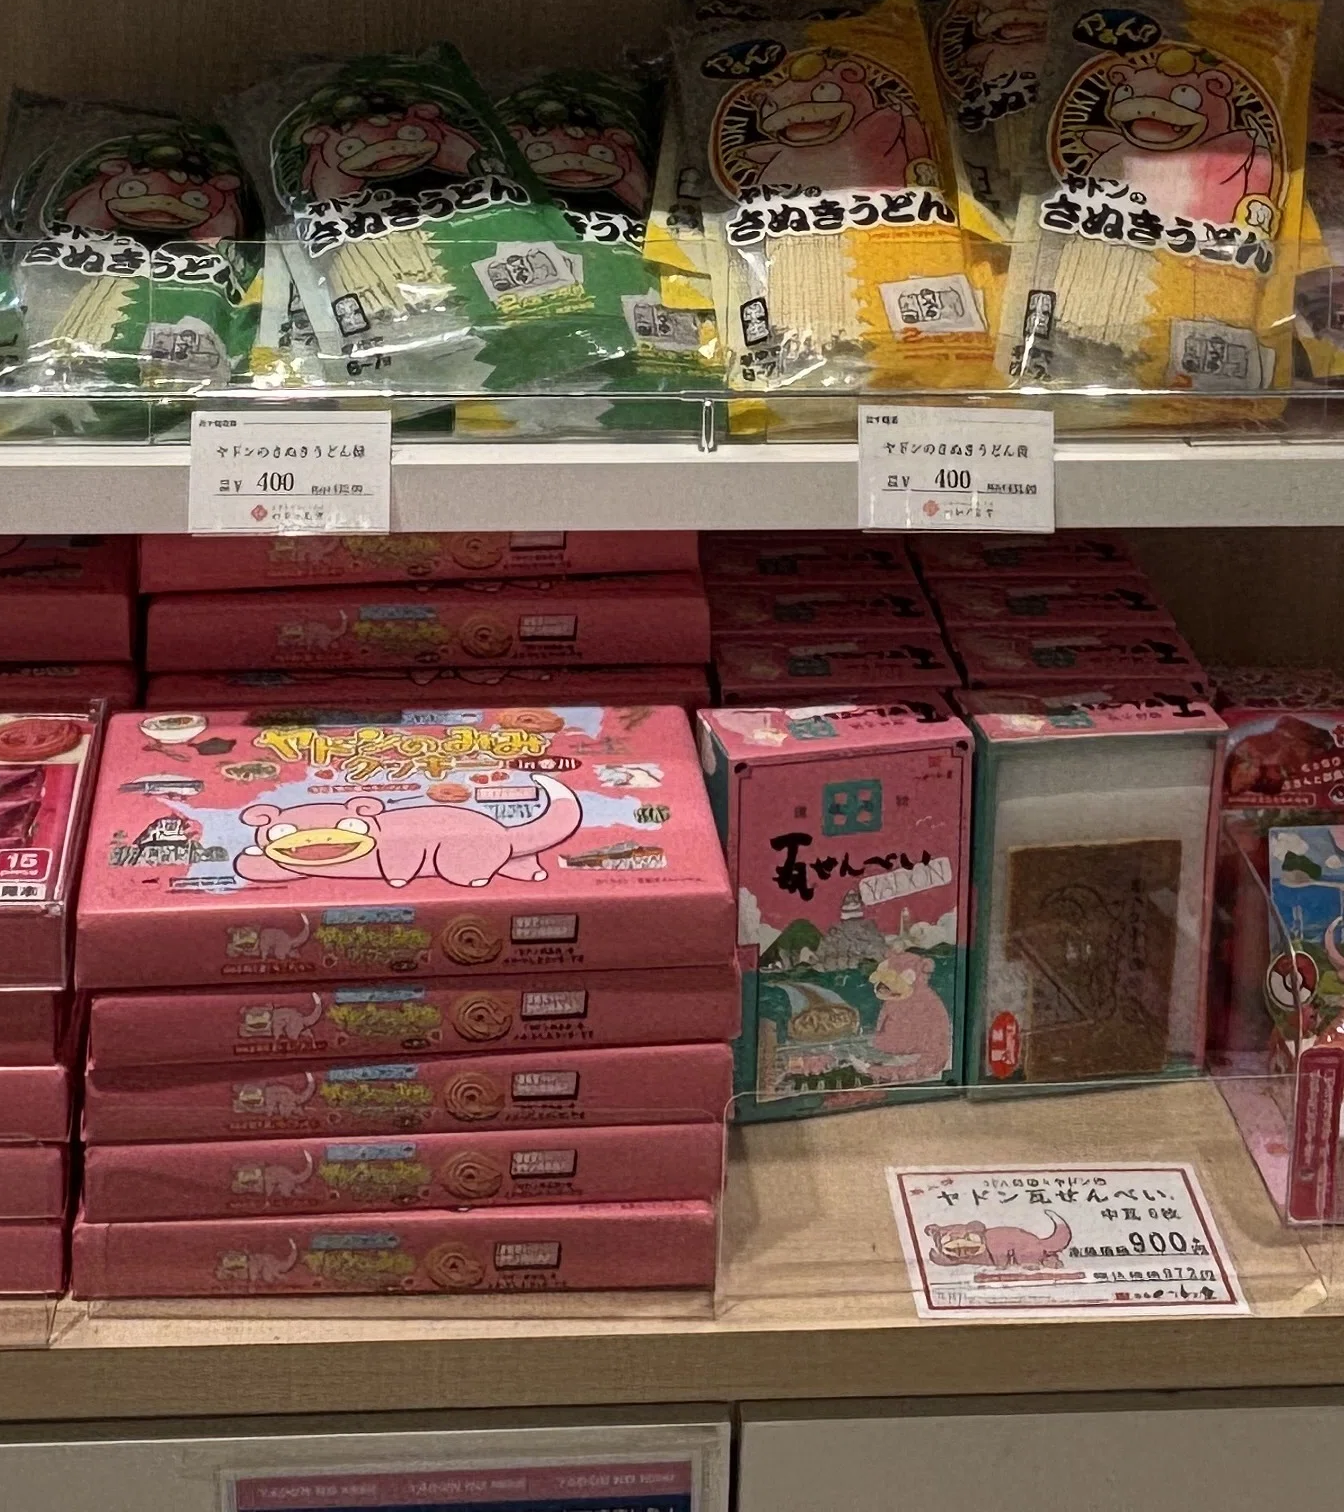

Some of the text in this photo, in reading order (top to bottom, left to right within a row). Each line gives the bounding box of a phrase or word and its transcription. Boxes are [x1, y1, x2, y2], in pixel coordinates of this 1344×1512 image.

[1061, 174, 1148, 205] ヤドンの
[309, 175, 529, 257] さぬきうどん
[729, 190, 955, 243] さぬきうどん
[1041, 194, 1274, 274] さぬきうどん
[256, 471, 295, 492] 400
[934, 468, 972, 489] 400
[254, 726, 549, 764] ヤドンのみみ
[937, 1187, 1175, 1205] ヤドン瓦せんべい
